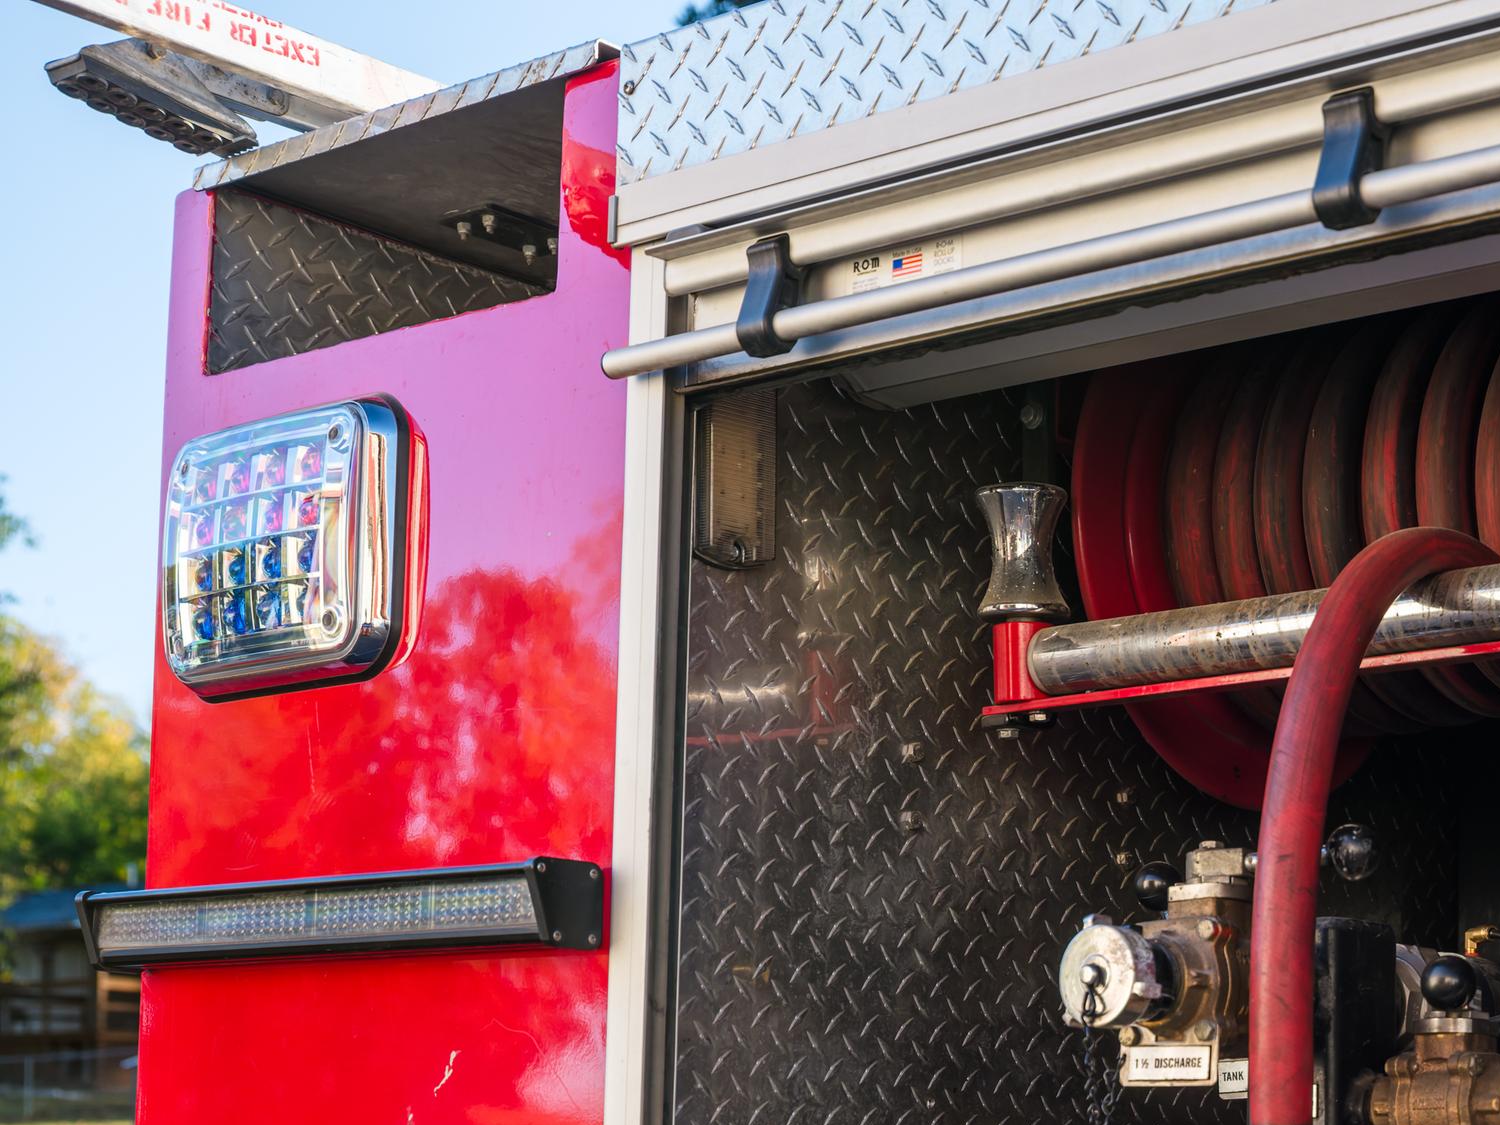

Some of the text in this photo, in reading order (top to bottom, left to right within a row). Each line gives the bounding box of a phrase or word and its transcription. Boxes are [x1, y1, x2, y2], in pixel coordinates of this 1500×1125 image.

[147, 1, 211, 33] FIRE
[230, 20, 320, 67] EXETER
[1154, 1057, 1202, 1069] DISCHARGE
[1222, 1071, 1245, 1081] TANK
